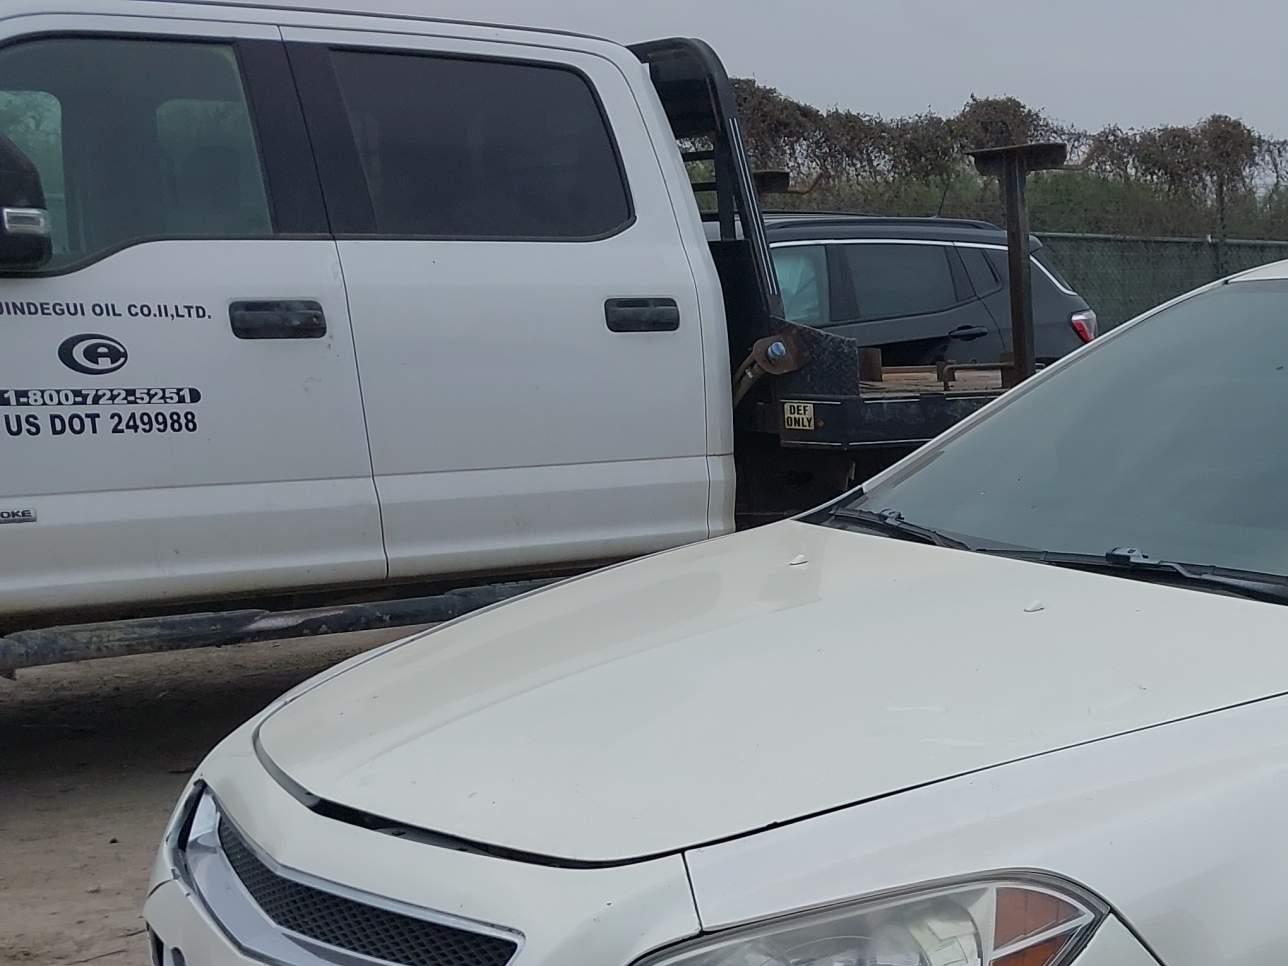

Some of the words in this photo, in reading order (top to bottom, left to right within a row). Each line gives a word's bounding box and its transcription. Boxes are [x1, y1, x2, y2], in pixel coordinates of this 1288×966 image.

[91, 303, 122, 317] OIL
[4, 388, 192, 405] 1-800-722-5251
[789, 405, 808, 415] DEF
[4, 414, 41, 436] US
[49, 412, 101, 435] DOT
[109, 411, 198, 434] 249988
[786, 416, 812, 427] ONLY
